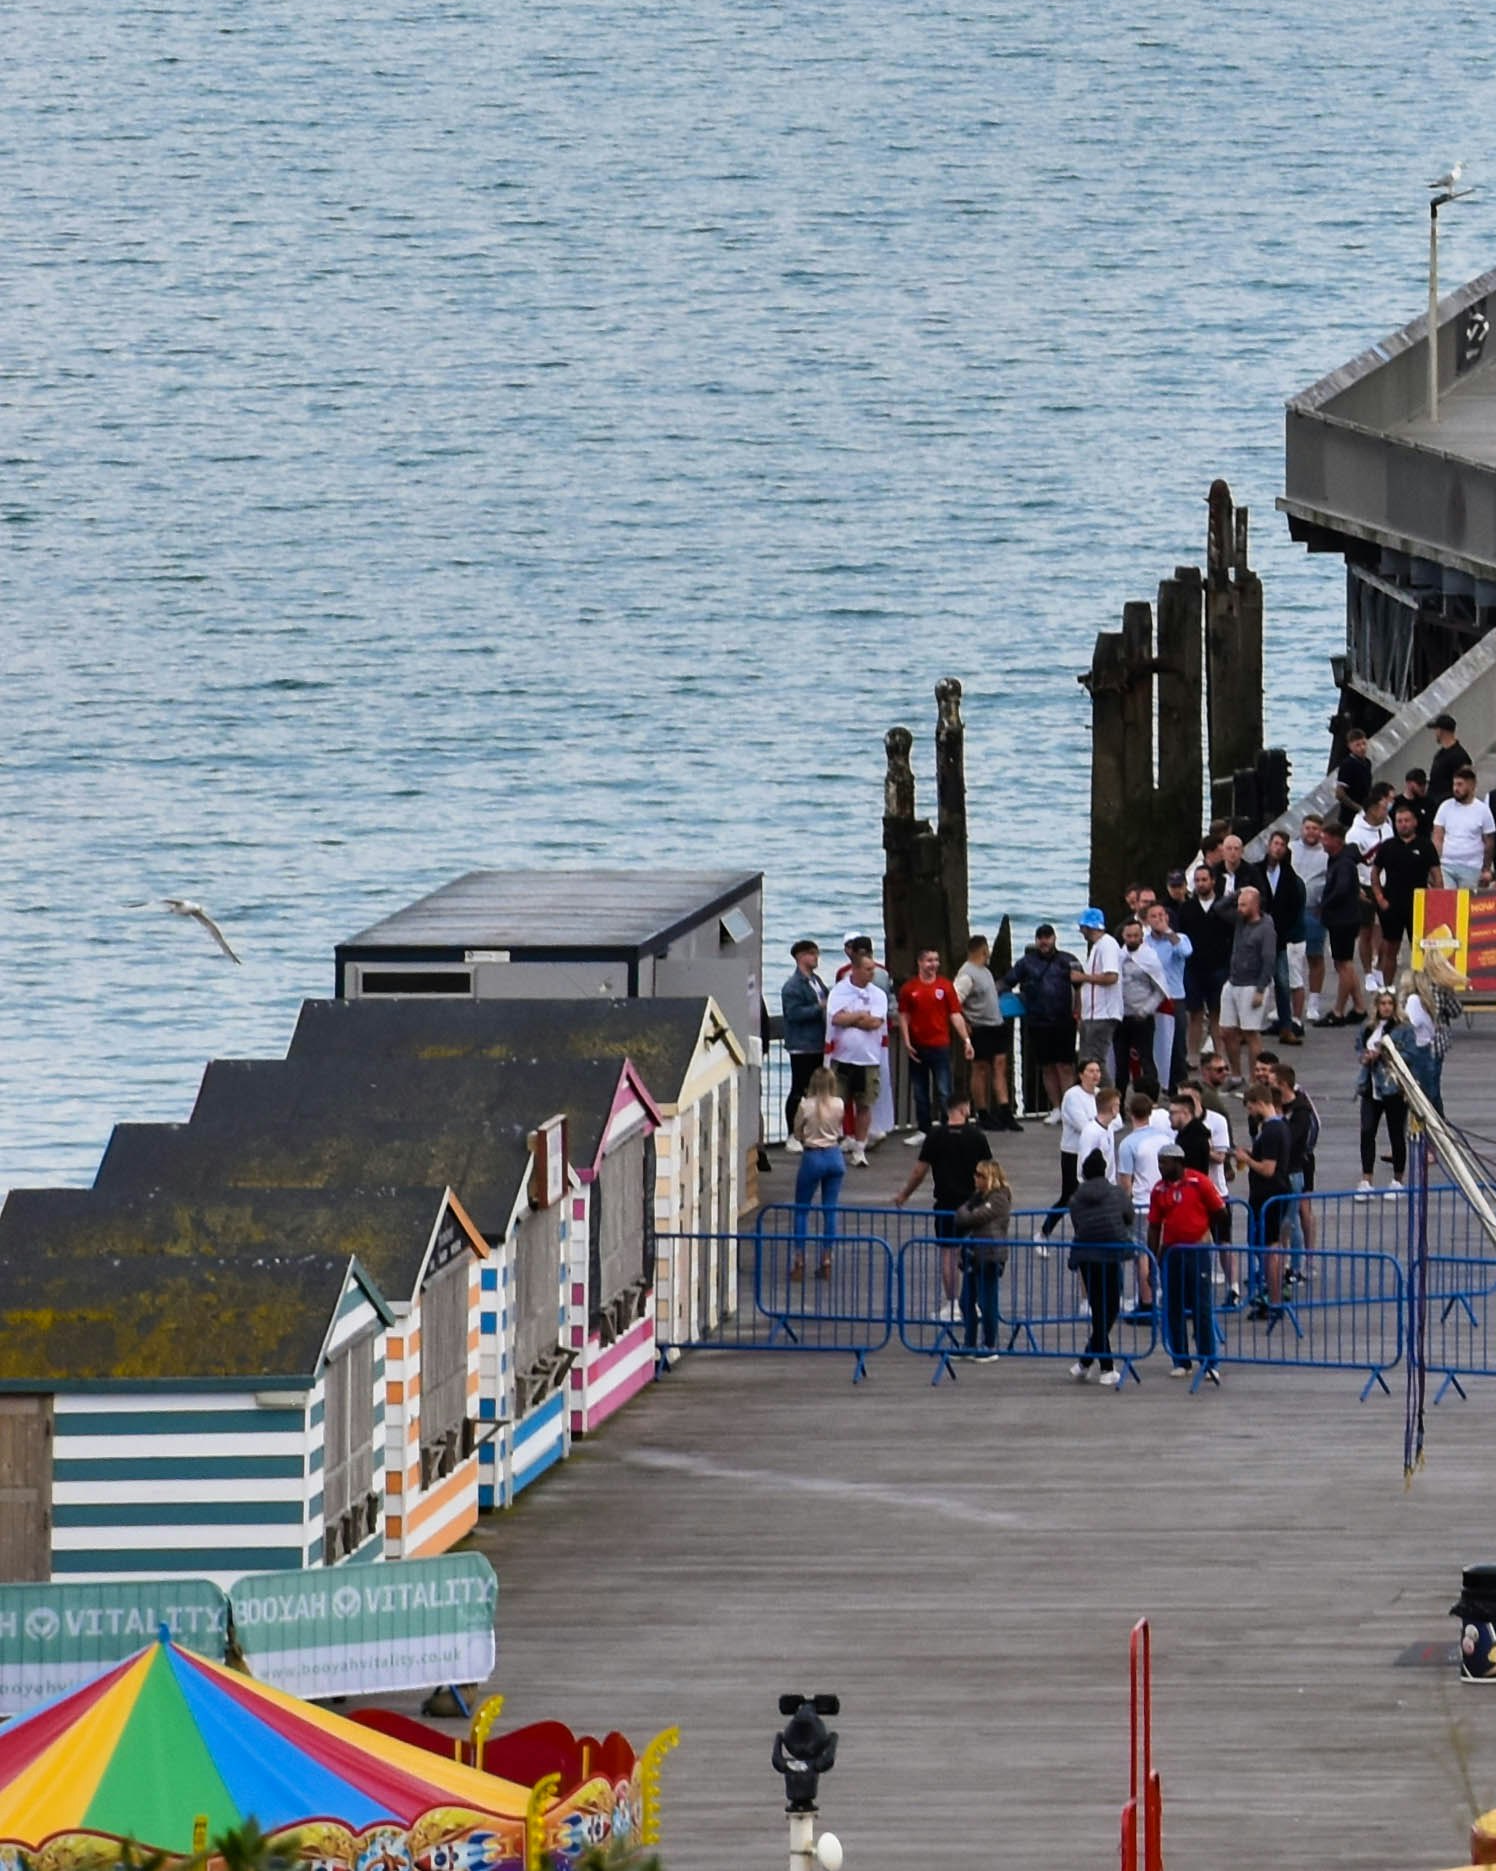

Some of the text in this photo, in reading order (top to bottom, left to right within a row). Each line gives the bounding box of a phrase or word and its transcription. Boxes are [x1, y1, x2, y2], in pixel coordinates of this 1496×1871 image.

[64, 1605, 224, 1637] VITALITY
[234, 1577, 493, 1626] BOOYAH VITALITY
